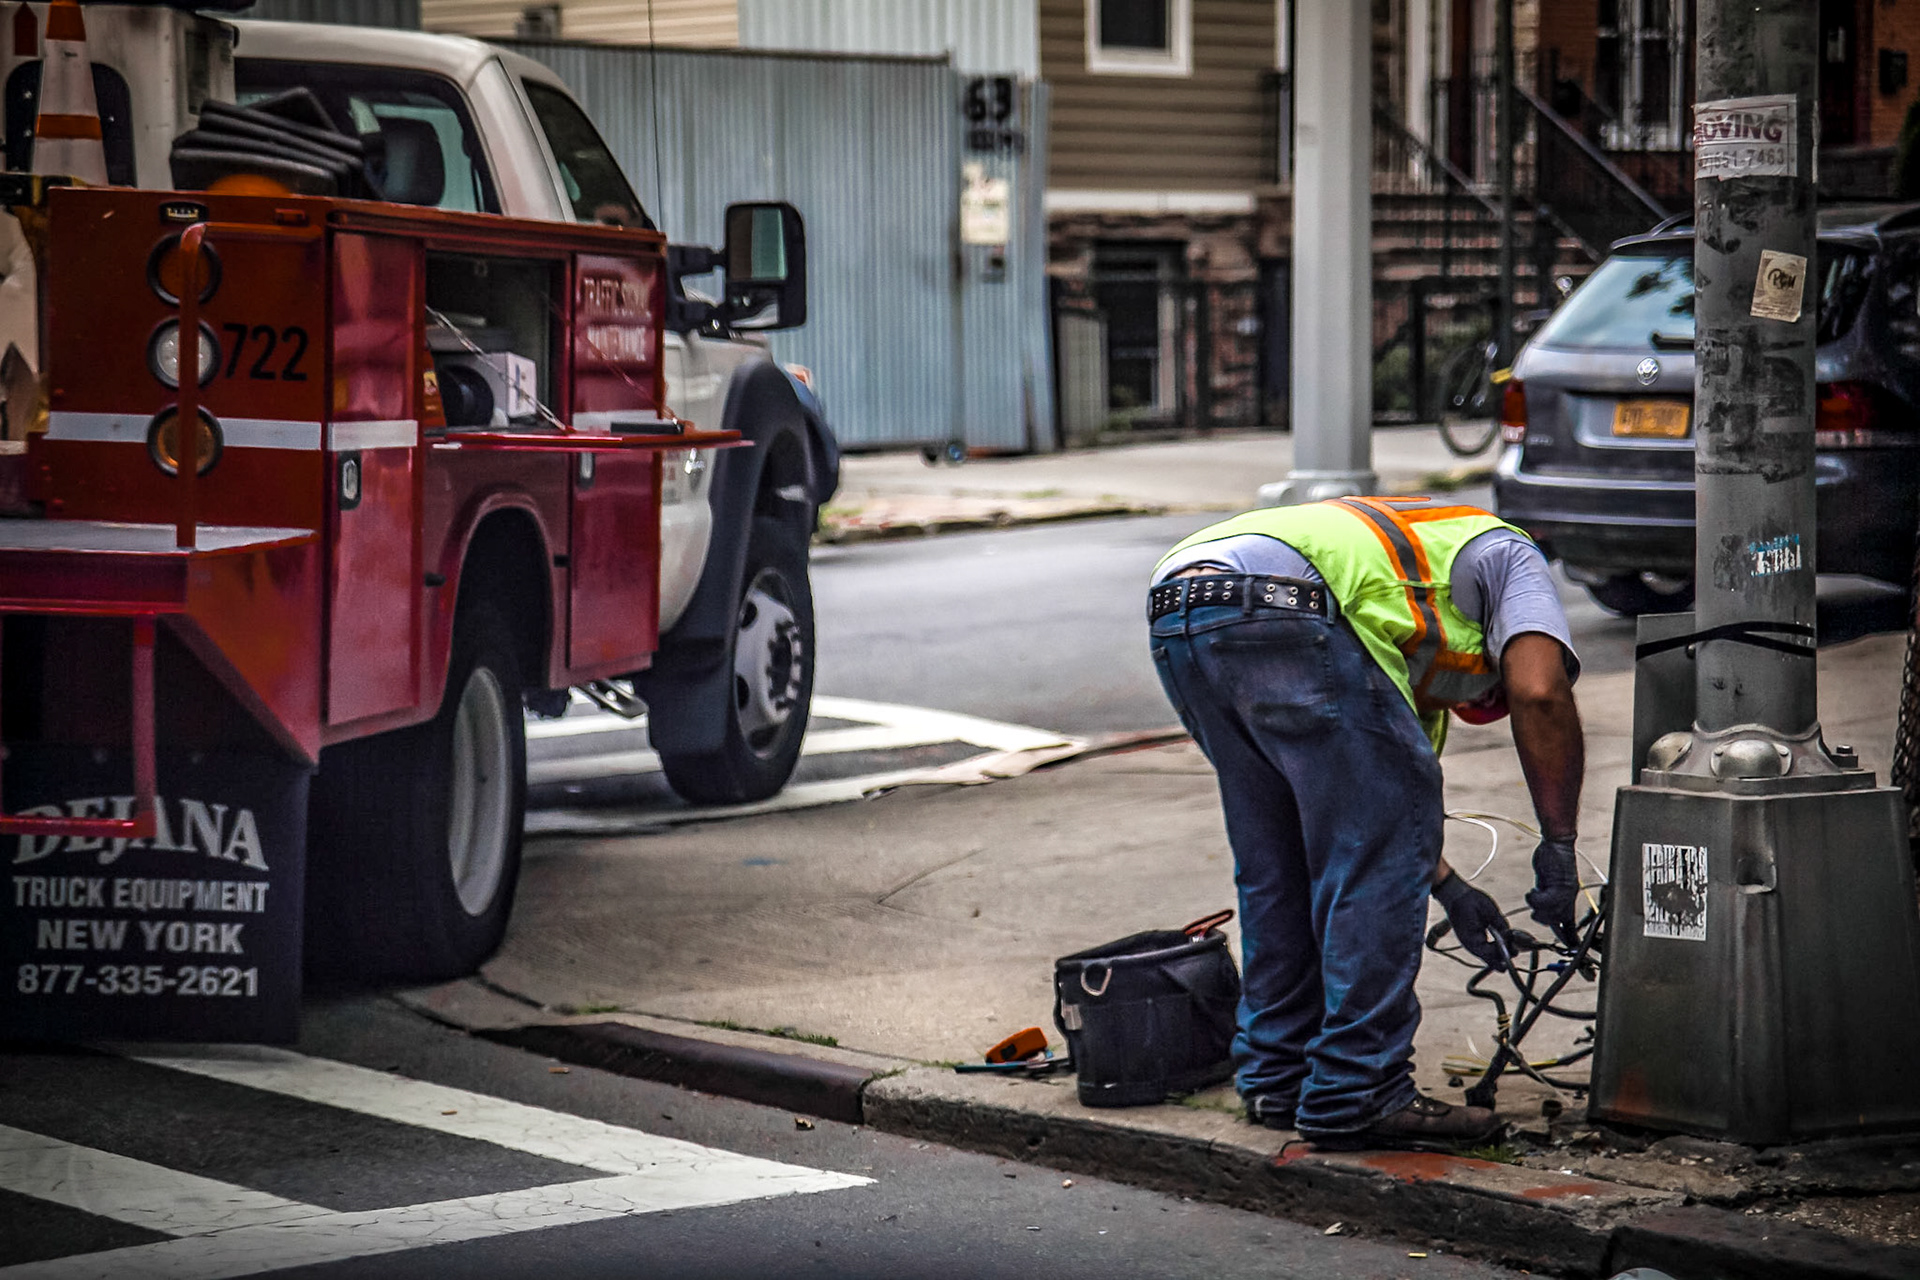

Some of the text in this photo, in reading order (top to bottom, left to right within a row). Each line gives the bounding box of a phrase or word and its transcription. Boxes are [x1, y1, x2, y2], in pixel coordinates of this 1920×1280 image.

[223, 322, 309, 382] 722
[12, 875, 270, 913] TRUCK EQUIPMENT
[37, 919, 245, 954] NEW YORK
[17, 963, 259, 997] 877-335-2621
